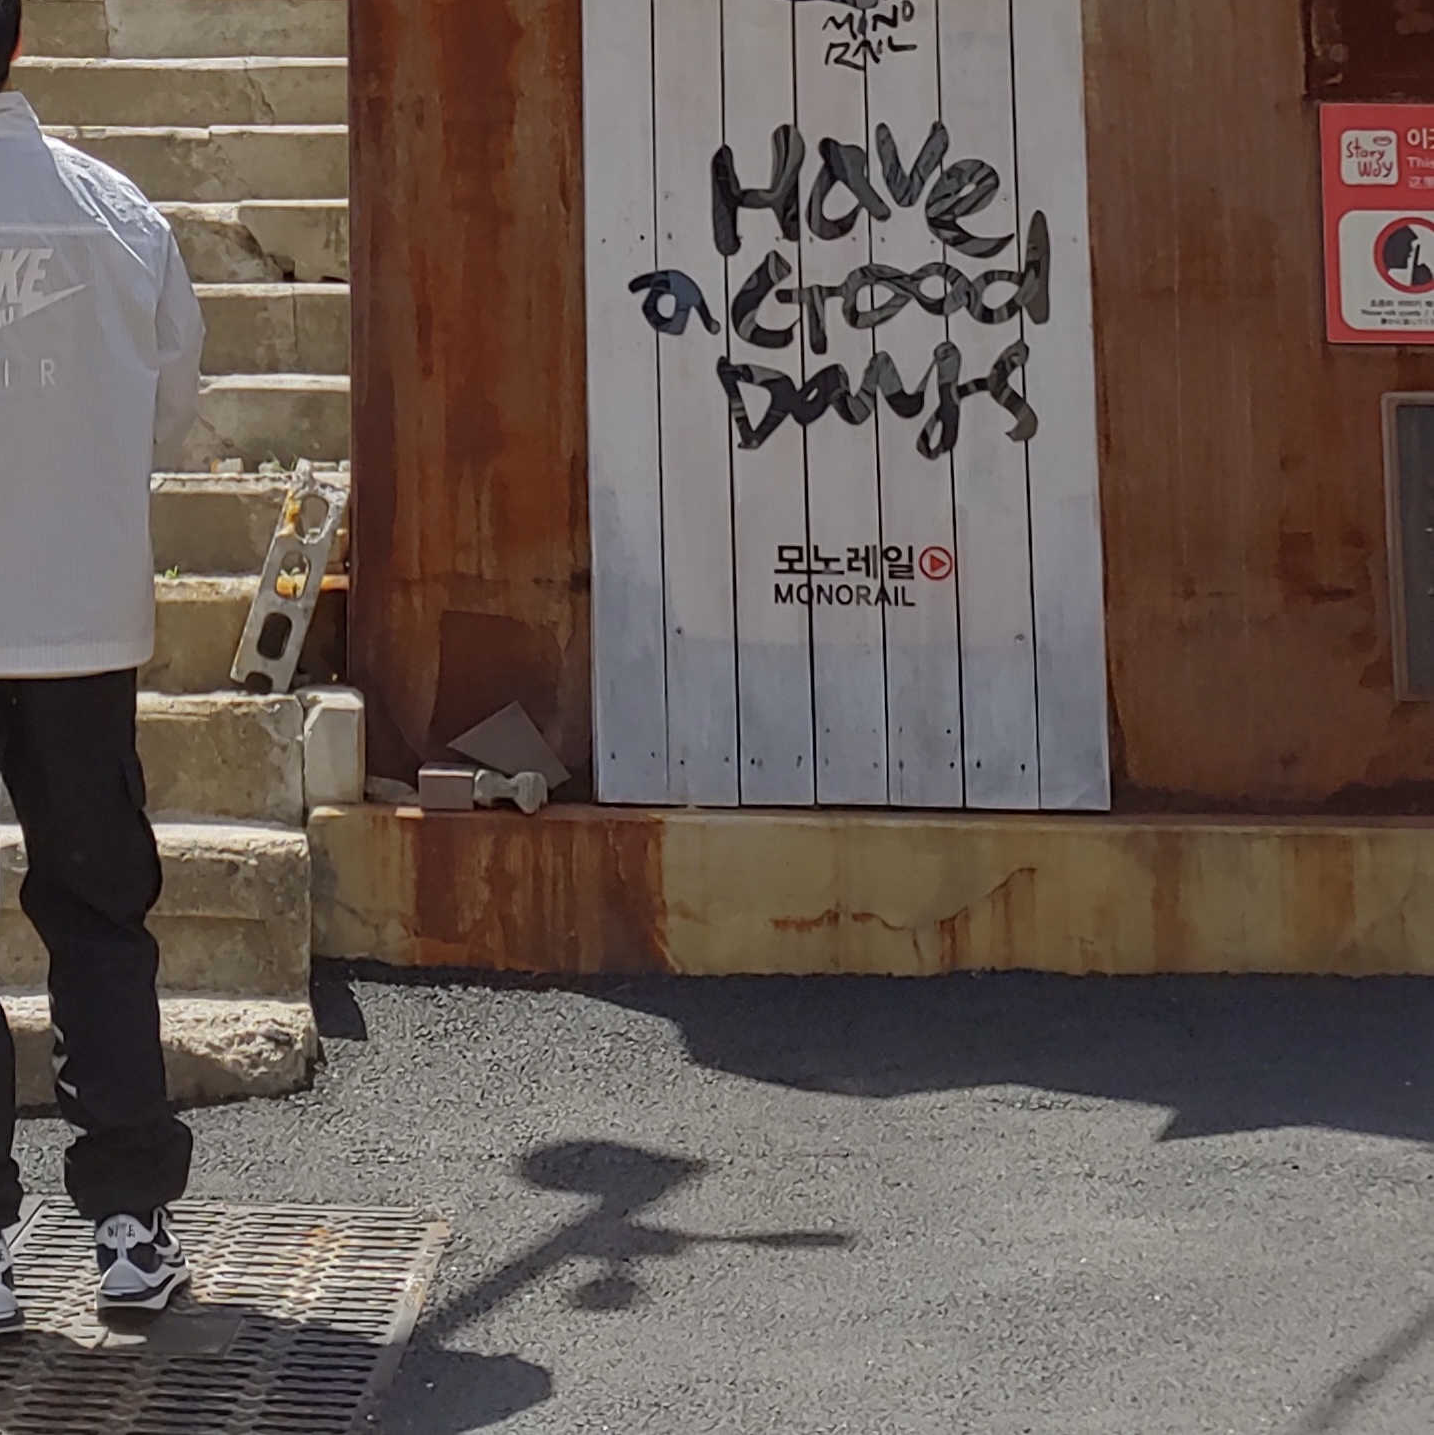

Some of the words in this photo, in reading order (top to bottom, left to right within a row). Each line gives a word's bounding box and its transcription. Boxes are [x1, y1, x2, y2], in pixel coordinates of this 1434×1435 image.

[824, 34, 918, 71] RAIL
[1346, 136, 1386, 164] Story
[628, 269, 720, 335] a
[732, 210, 1050, 354] Good
[774, 544, 915, 581] 모노레일
[774, 583, 916, 607] MONORAIL
